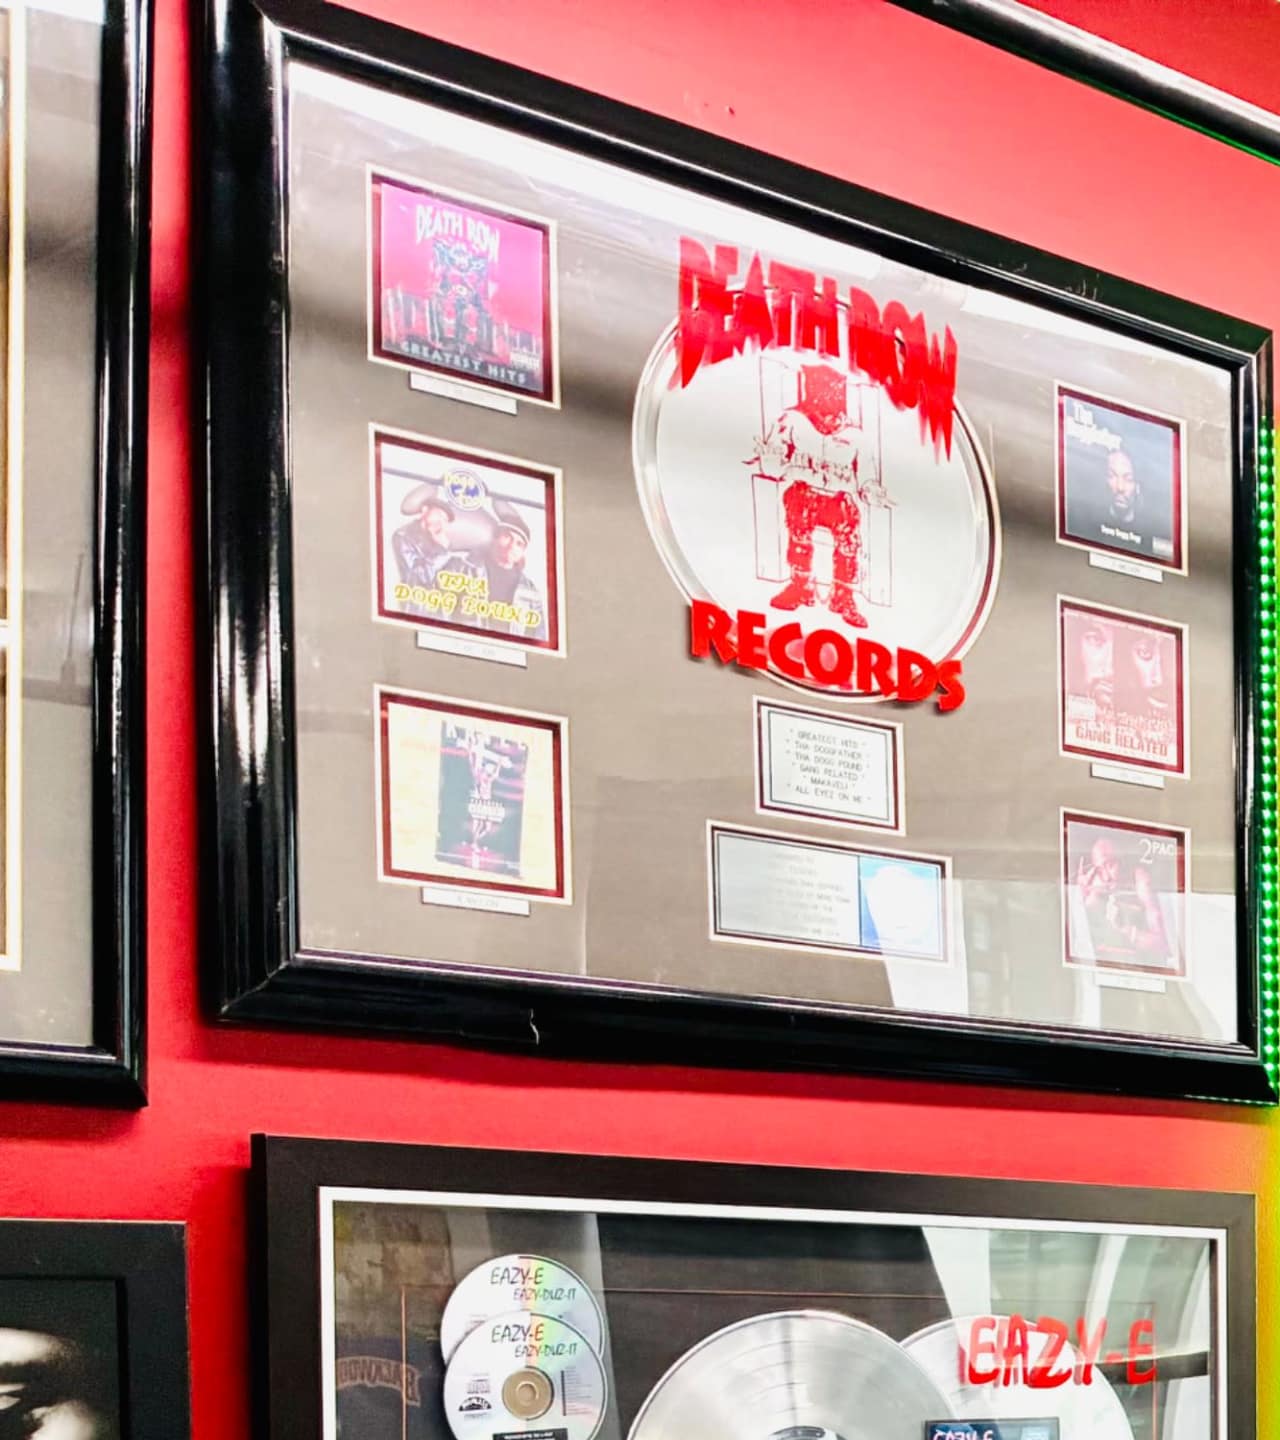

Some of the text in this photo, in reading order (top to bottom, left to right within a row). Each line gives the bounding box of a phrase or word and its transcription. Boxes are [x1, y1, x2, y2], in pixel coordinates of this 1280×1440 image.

[416, 205, 499, 263] DEATH ROW
[678, 237, 957, 461] DEATH ROW
[488, 364, 527, 384] HITS
[394, 584, 542, 628] DOGG POUND
[690, 600, 965, 713] RECORDS
[1138, 837, 1176, 866] 2PAC
[490, 1266, 544, 1285] EAZY-E
[513, 1288, 577, 1301] EAZY-DUZ-IT
[491, 1323, 544, 1343] EAZY-E
[514, 1343, 577, 1358] EAZY-DUZ-IT
[958, 1314, 1158, 1388] EAZY-E
